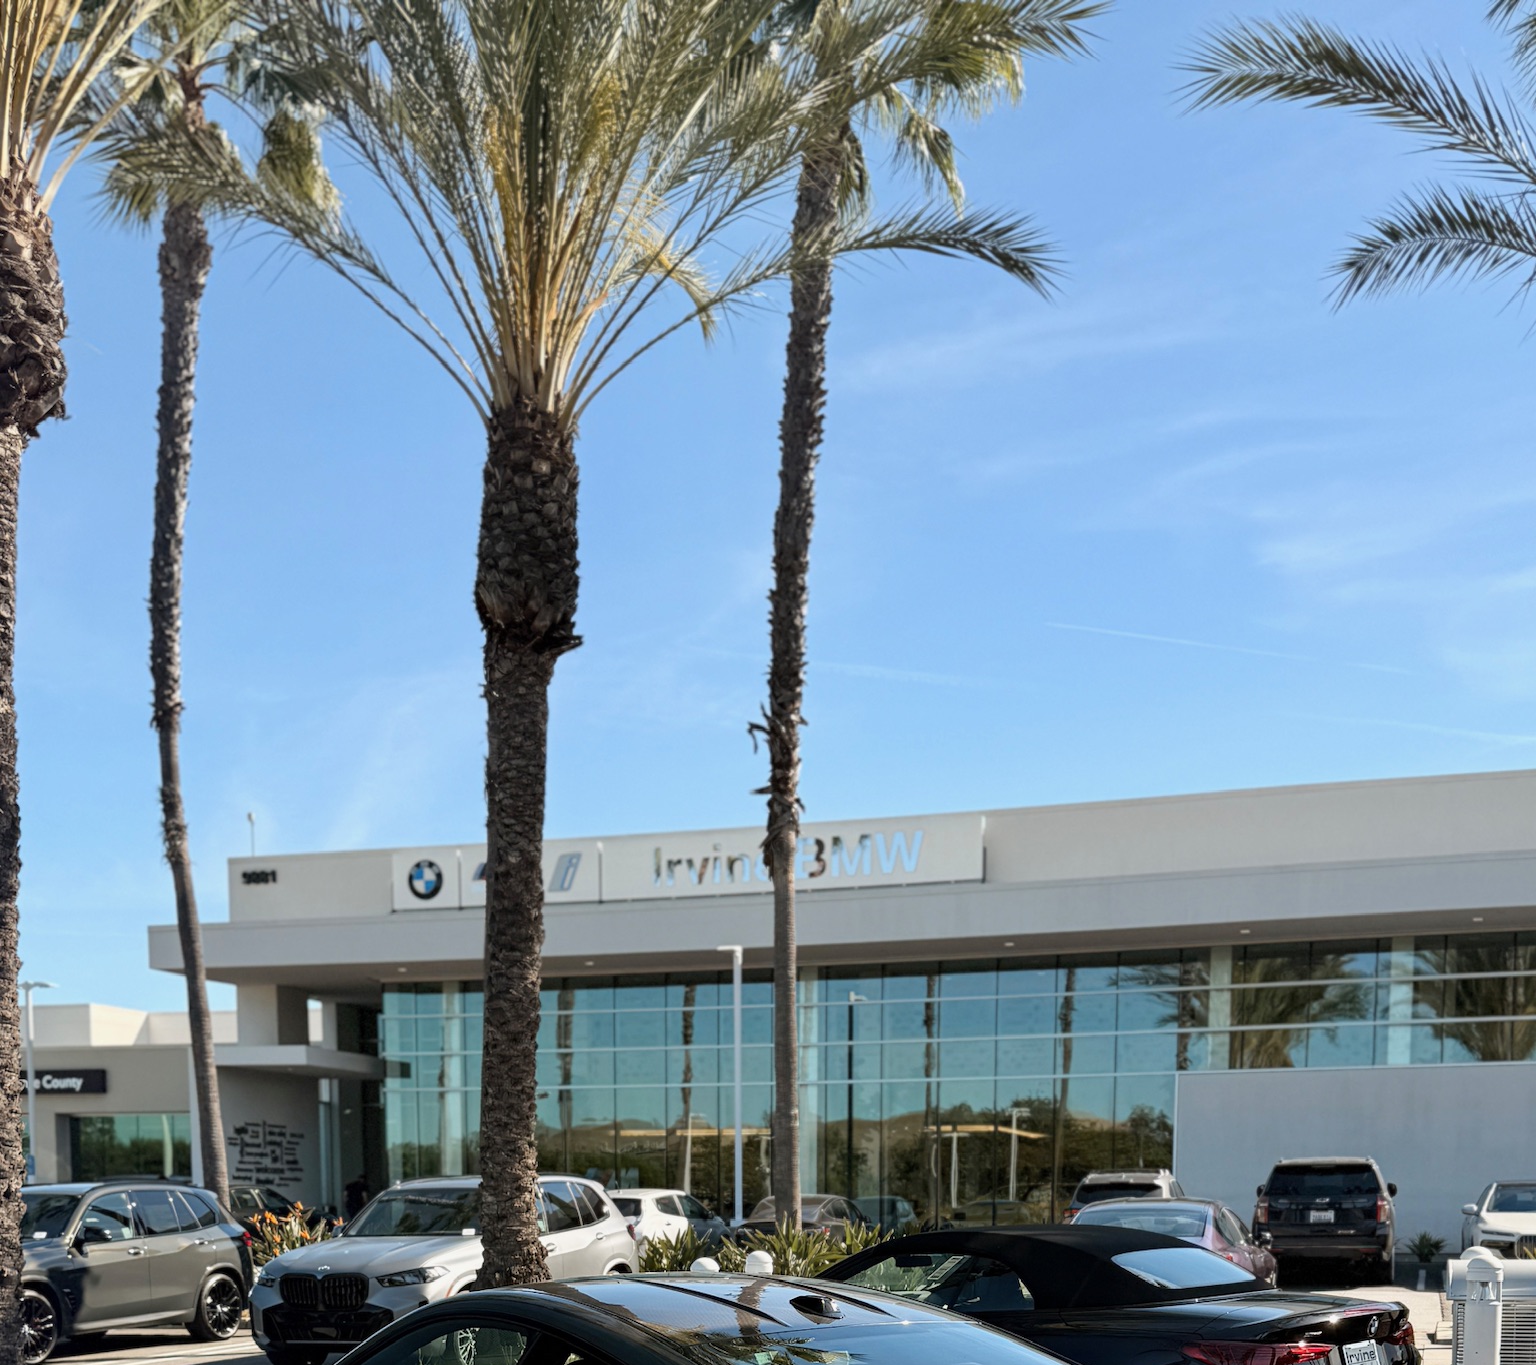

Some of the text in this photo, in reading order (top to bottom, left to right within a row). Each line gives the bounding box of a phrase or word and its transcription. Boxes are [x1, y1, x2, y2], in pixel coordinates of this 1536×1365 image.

[795, 831, 924, 879] BMW
[42, 1074, 83, 1092] County
[1346, 1349, 1376, 1364] Irvine
